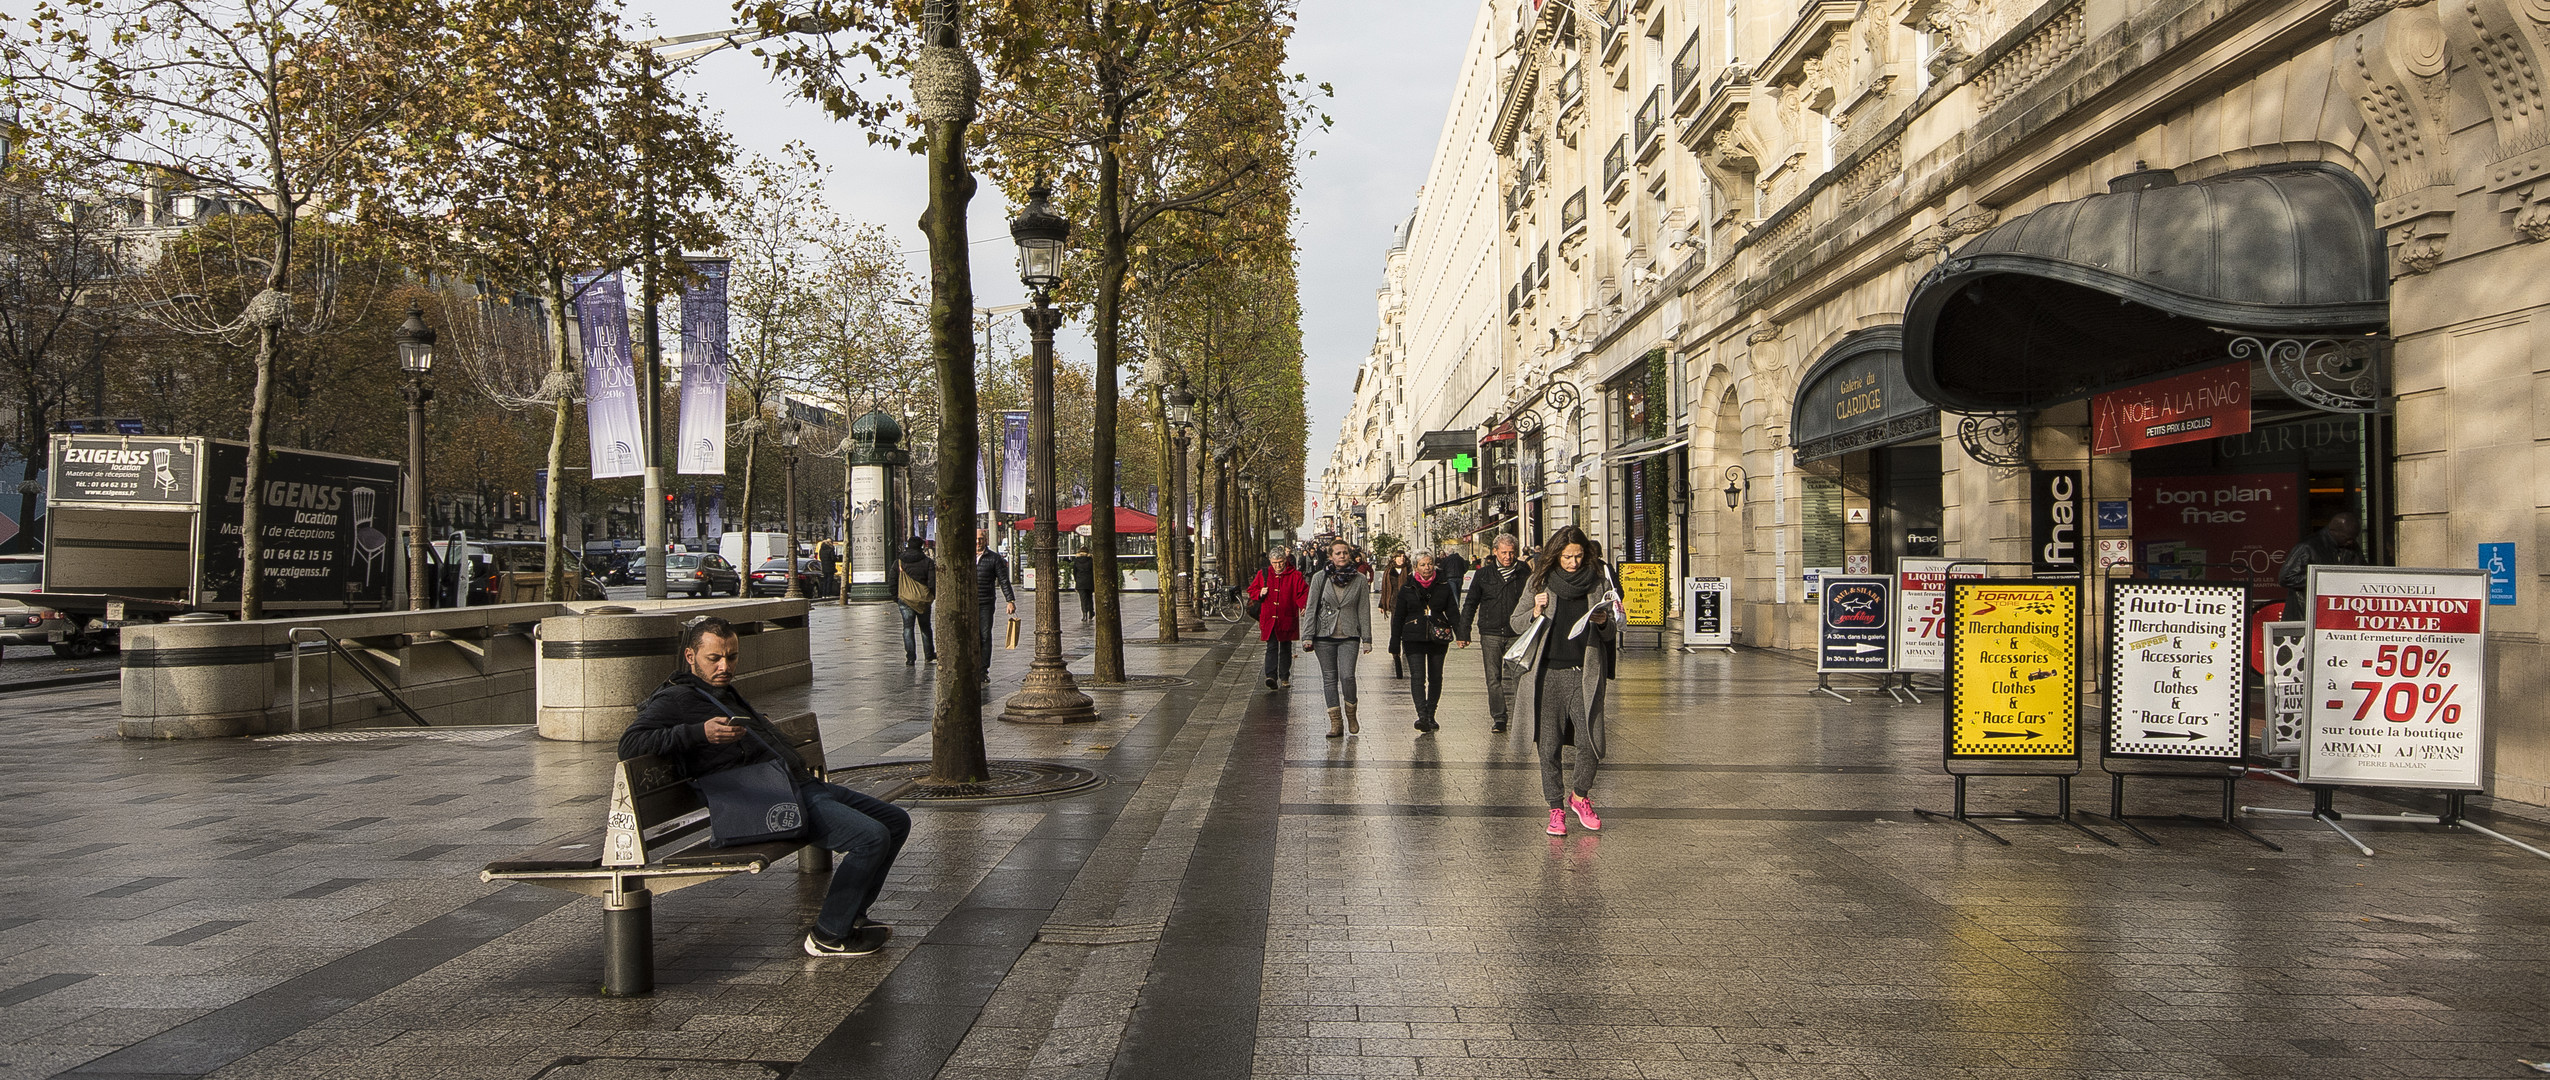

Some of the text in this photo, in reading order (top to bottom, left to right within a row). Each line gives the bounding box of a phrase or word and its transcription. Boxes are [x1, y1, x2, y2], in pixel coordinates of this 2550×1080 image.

[595, 326, 617, 347] ILLU
[696, 321, 715, 342] ILLU
[585, 347, 622, 368] MINA
[685, 342, 718, 363] MINA
[596, 365, 635, 388] TIONS
[694, 363, 727, 385] TIONS
[1840, 371, 1875, 395] Galerie du
[603, 390, 625, 399] 2016
[1836, 388, 1881, 420] CLARIDGE
[2121, 381, 2241, 425] NOËL À LA FNAC
[2146, 418, 2211, 437] PETITS PRIX & EXCLUS
[2221, 419, 2357, 458] CLARIDG
[65, 449, 150, 465] EXIGENSS
[226, 476, 343, 510] EIGENSS
[2156, 485, 2272, 506] bon plan
[294, 510, 338, 525] location
[2043, 475, 2074, 564] fnac
[2181, 507, 2246, 524] fnac
[220, 523, 335, 540] Matl de réceptions
[1907, 533, 1938, 543] fnac
[263, 549, 333, 561] 01 64 62 15 15
[2230, 549, 2286, 574] 50€
[1833, 588, 1850, 604] PAUL
[1856, 587, 1881, 604] SHARK
[1975, 591, 2054, 601] FORMULA
[2359, 584, 2435, 595] ANTONELLI
[1925, 598, 1945, 615] -5
[2130, 597, 2227, 615] Auto-Line
[2328, 597, 2469, 614] LIQUIDATION
[1833, 611, 1876, 625] yachting
[2355, 615, 2441, 631] TOTALE
[1907, 617, 1945, 639] -70
[1968, 621, 2060, 638] Merchandising
[2129, 619, 2227, 639] Merchandising
[2010, 637, 2018, 650] &
[2173, 636, 2182, 649] &
[2325, 632, 2465, 645] Avant fermeture définitive
[1980, 651, 2049, 664] Accessories
[2141, 650, 2213, 664] Accessories
[2327, 656, 2348, 668] de
[2362, 644, 2451, 678] -50%
[2010, 667, 2018, 679] &
[2172, 666, 2181, 679] &
[1992, 681, 2036, 694] Clothes
[2153, 680, 2198, 695] Clothes
[2328, 679, 2337, 690] à
[2009, 696, 2018, 709] &
[2171, 697, 2181, 710] &
[2326, 681, 2461, 724] -70%
[2322, 726, 2464, 741] sur toute la boutique
[2320, 742, 2464, 757] ARMANI AJ ARMANI
[2389, 761, 2427, 769] BALMAIN
[782, 819, 794, 827] 96
